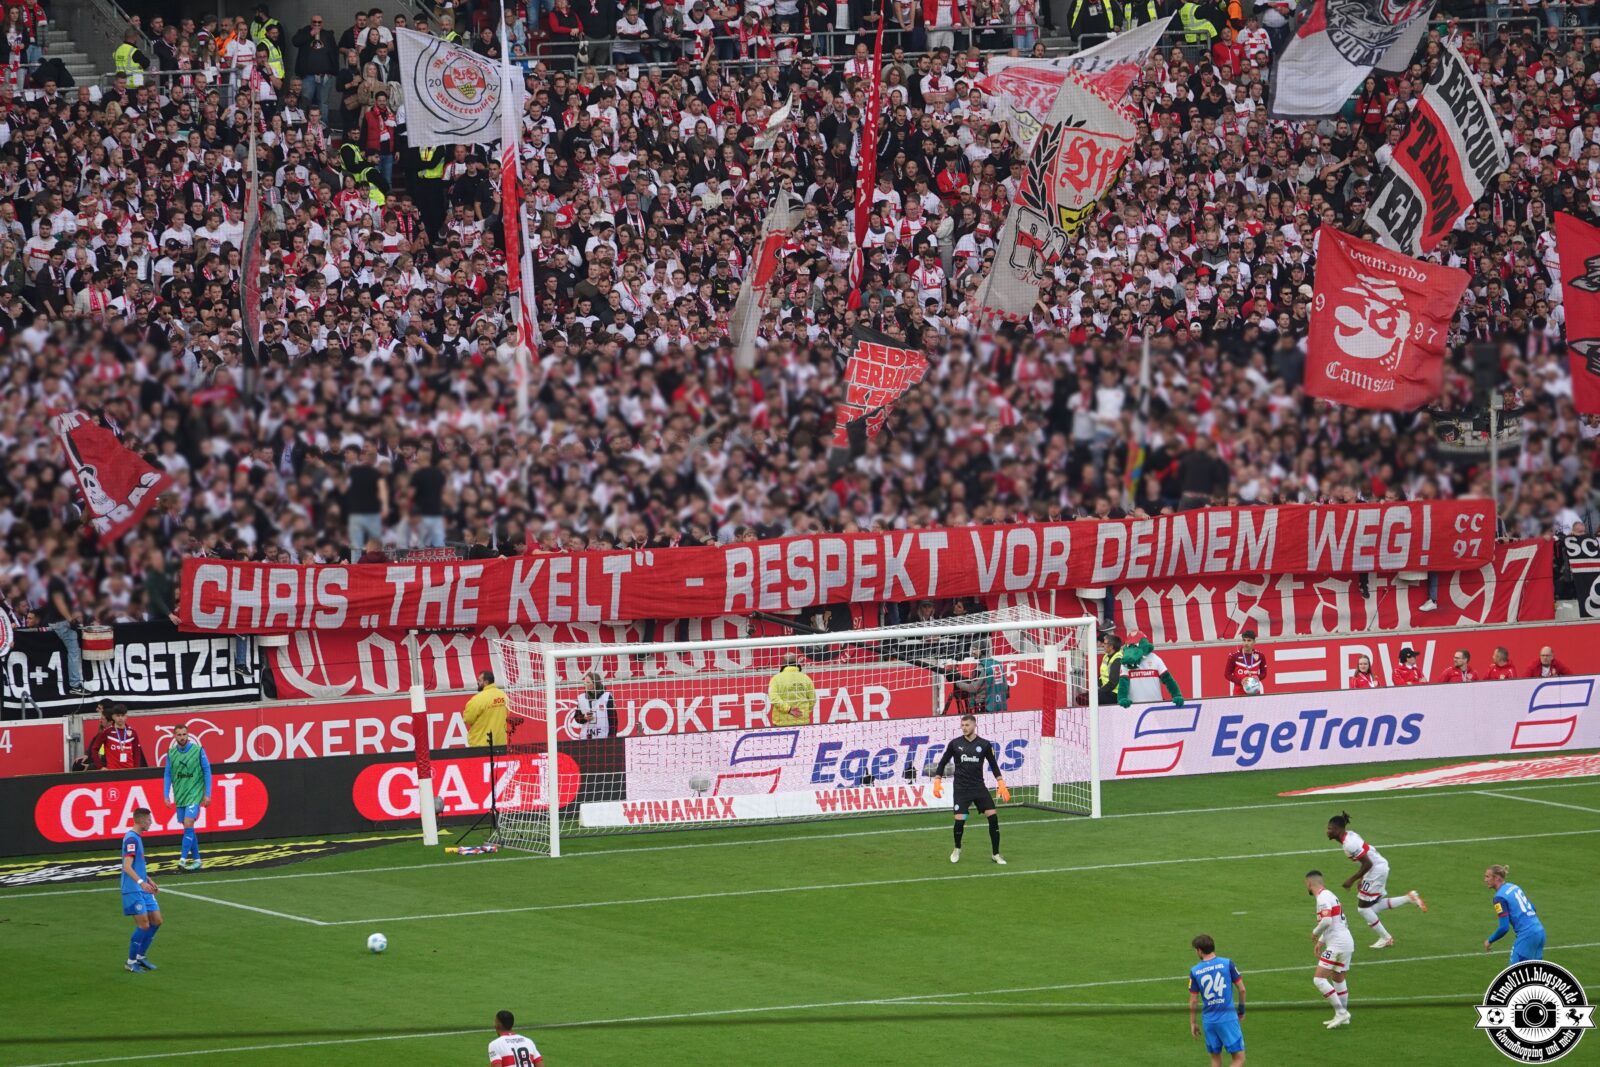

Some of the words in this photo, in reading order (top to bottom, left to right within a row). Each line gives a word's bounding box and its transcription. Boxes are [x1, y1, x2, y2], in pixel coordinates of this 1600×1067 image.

[1414, 321, 1439, 345] 97
[1453, 513, 1485, 534] CC
[1453, 538, 1482, 559] 97
[191, 564, 349, 629] CHRIS
[724, 531, 948, 612] RESPEKT
[970, 526, 1071, 593] VOR
[1091, 508, 1279, 584] DEINEM
[1307, 504, 1432, 572] WEG!
[996, 572, 1420, 652] Cnnstatt
[1449, 545, 1538, 627] 97
[852, 616, 863, 629] 97
[616, 685, 893, 738] JOKERTAR
[1211, 709, 1425, 767] EgeTrans
[622, 796, 737, 825] WINAMAX
[815, 785, 929, 812] WINAMAX
[1200, 971, 1227, 1000] 24
[511, 1047, 532, 1067] 18
